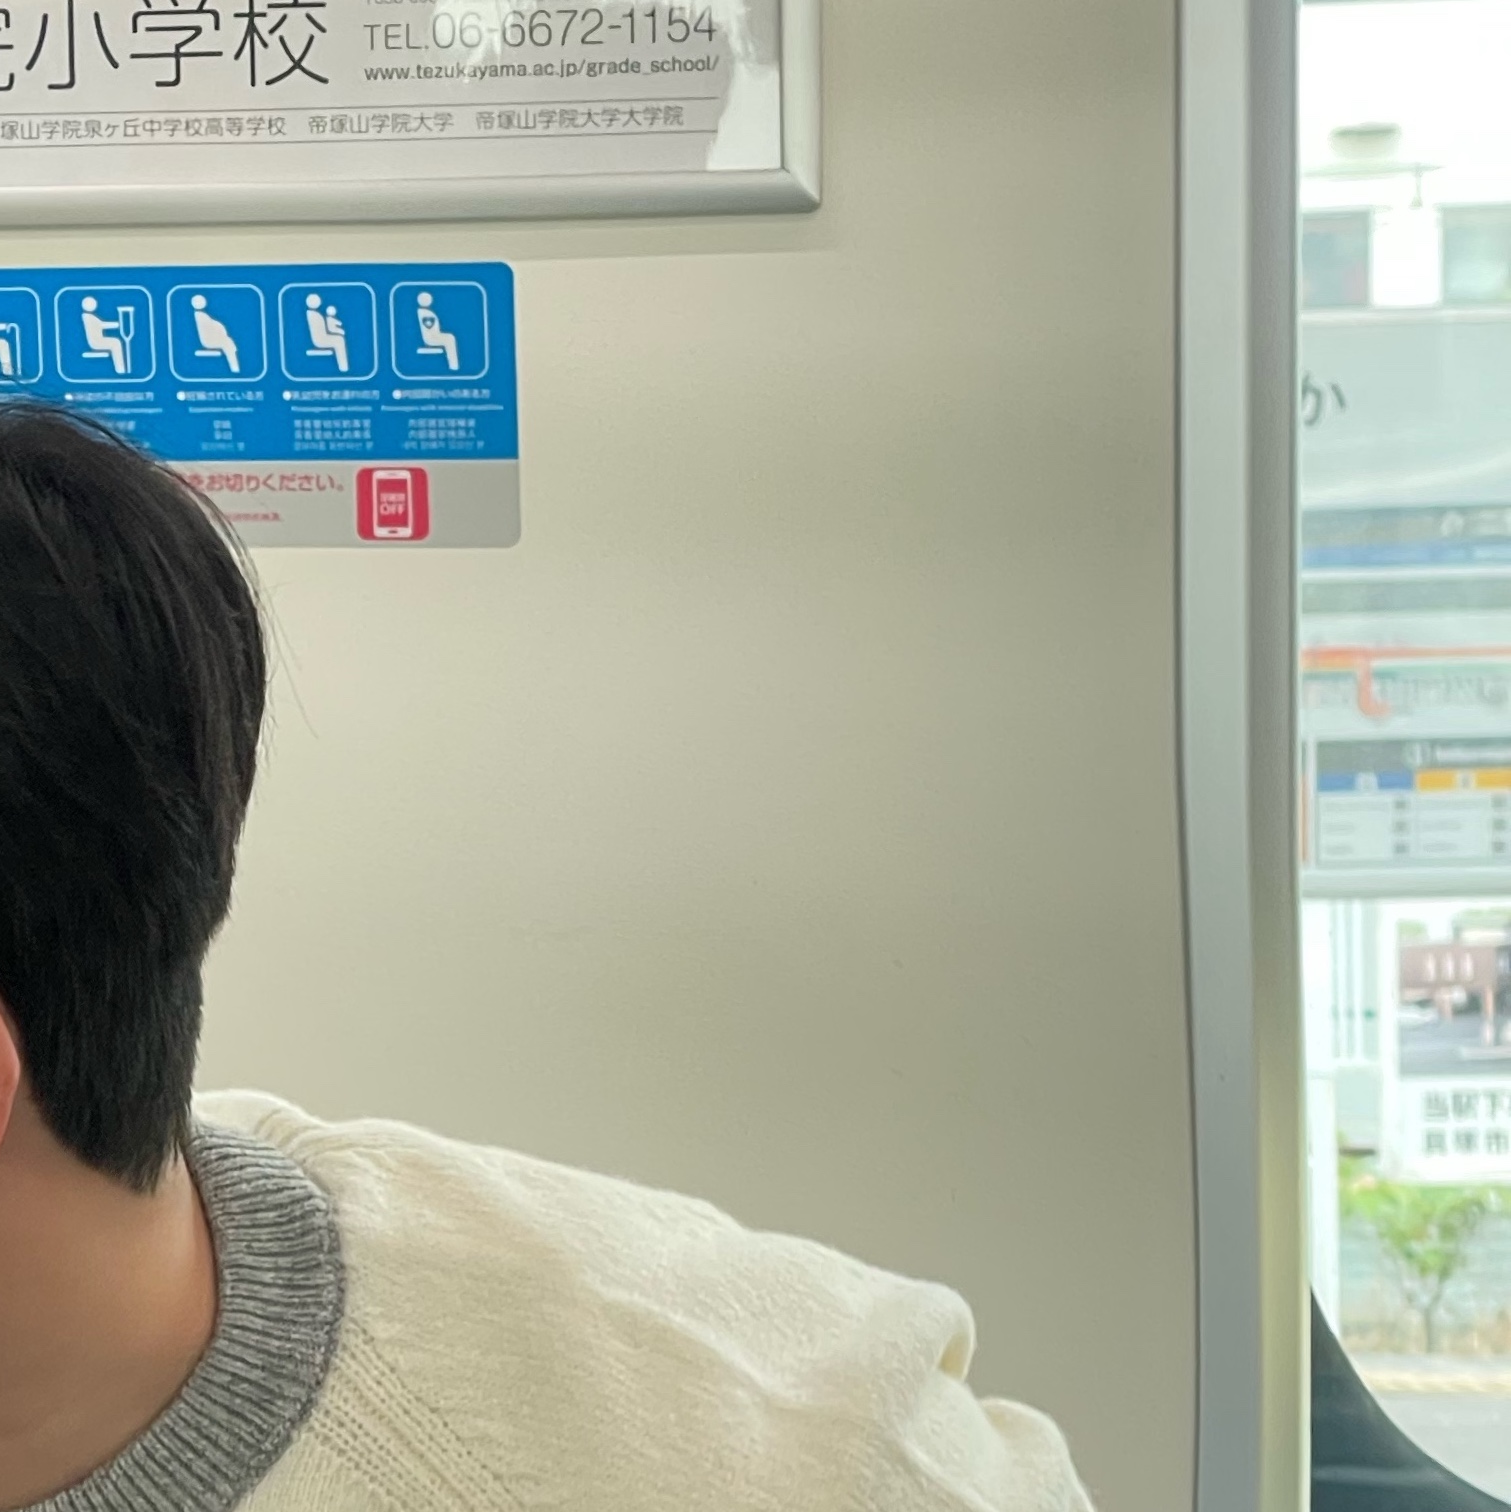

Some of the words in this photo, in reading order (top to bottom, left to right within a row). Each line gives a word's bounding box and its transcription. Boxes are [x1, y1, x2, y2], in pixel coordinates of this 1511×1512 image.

[363, 5, 719, 51] TEL.06-6672-1154
[364, 55, 720, 82] www.tezukayama.ac.jp/grade_school/
[307, 110, 455, 135] 帝塚山学院大学
[475, 104, 686, 132] 帝塚山学院大学大学院
